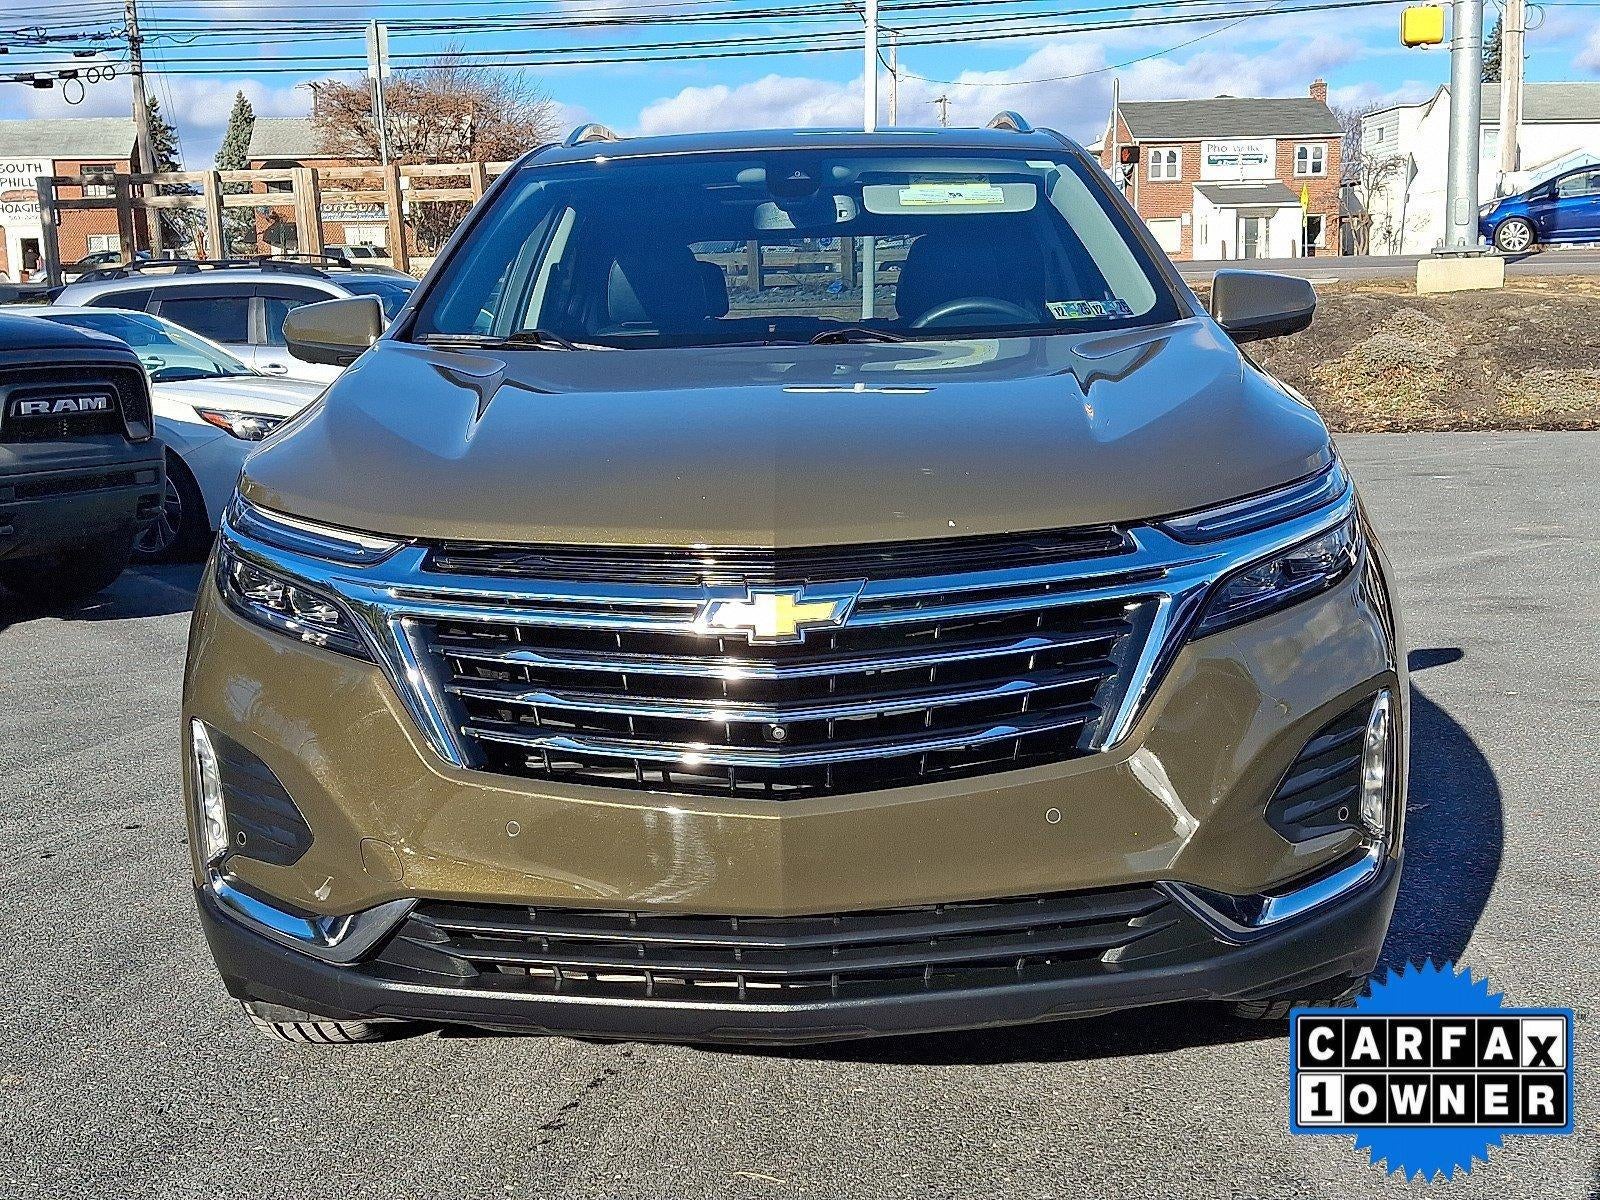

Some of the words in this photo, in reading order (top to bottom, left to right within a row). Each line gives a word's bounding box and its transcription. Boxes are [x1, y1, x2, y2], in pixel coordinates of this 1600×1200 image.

[1207, 143, 1228, 153] Pho
[0, 163, 42, 174] SOUTH
[0, 177, 38, 188] PHILL
[20, 396, 107, 415] RAM
